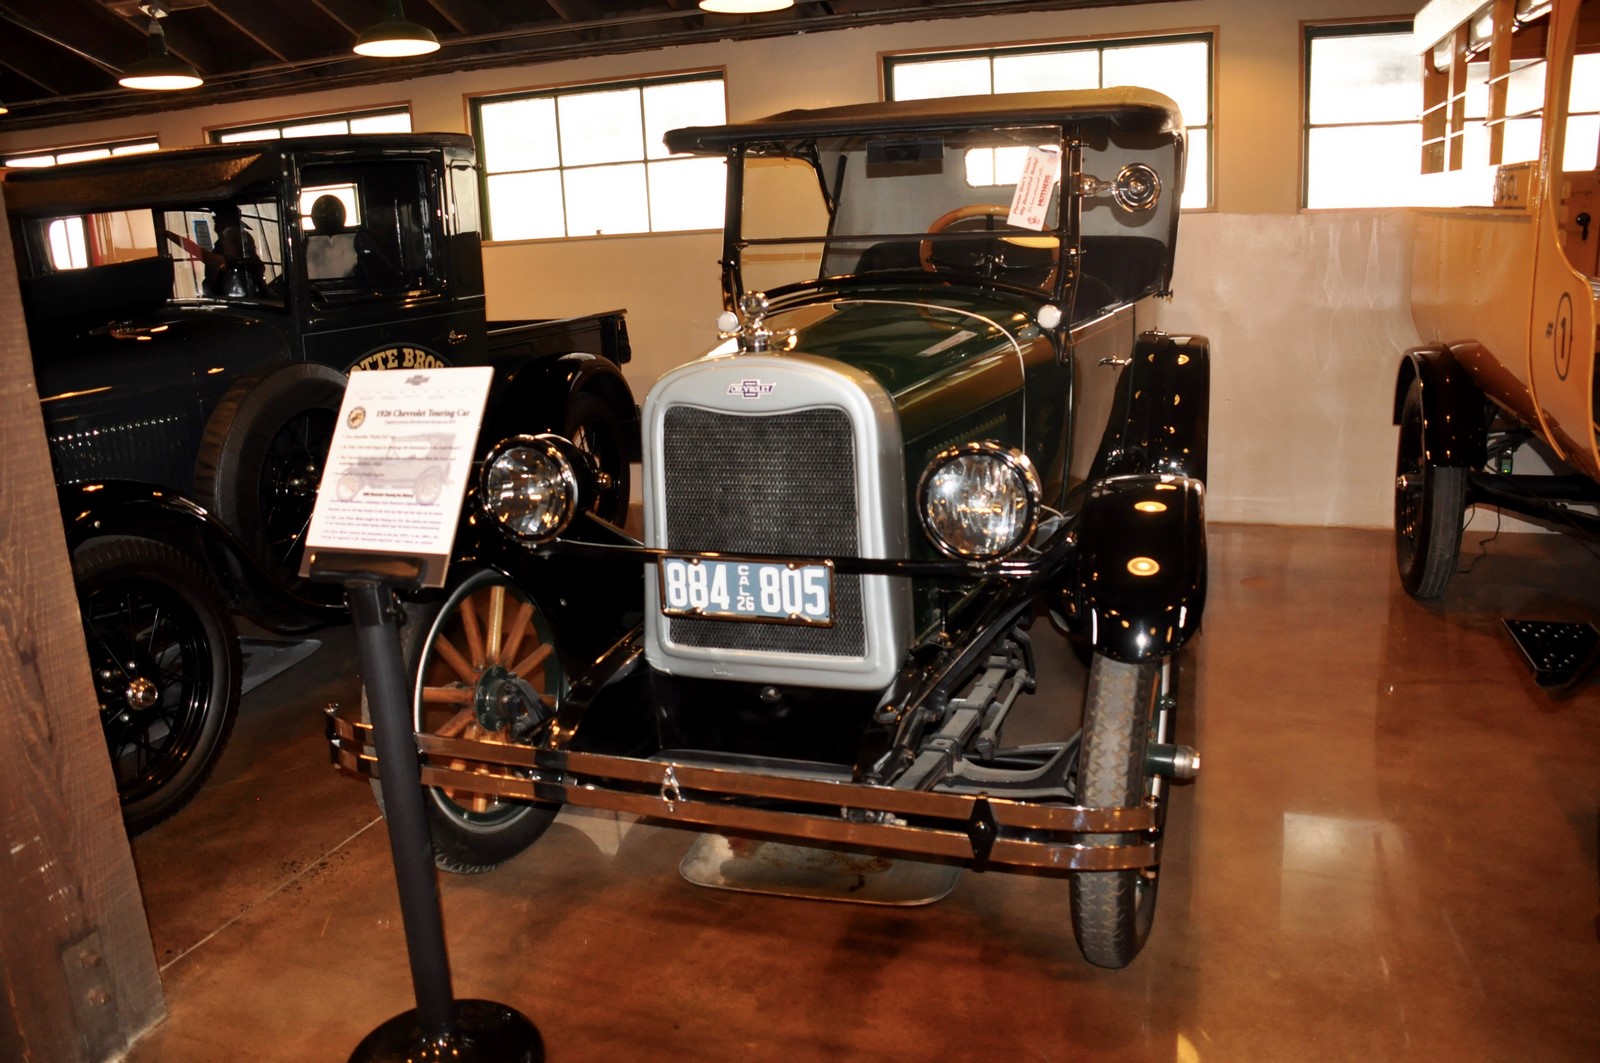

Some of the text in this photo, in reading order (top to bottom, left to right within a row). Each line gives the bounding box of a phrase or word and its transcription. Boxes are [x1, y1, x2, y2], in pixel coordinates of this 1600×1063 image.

[1037, 174, 1051, 207] MOTHERS
[1560, 317, 1566, 360] 1
[728, 382, 774, 394] CHEVROLET
[376, 408, 470, 418] 1926 Chevrolet Touring Car
[666, 562, 826, 616] 884 805
[737, 565, 750, 596] CAL
[737, 596, 755, 611] 26
